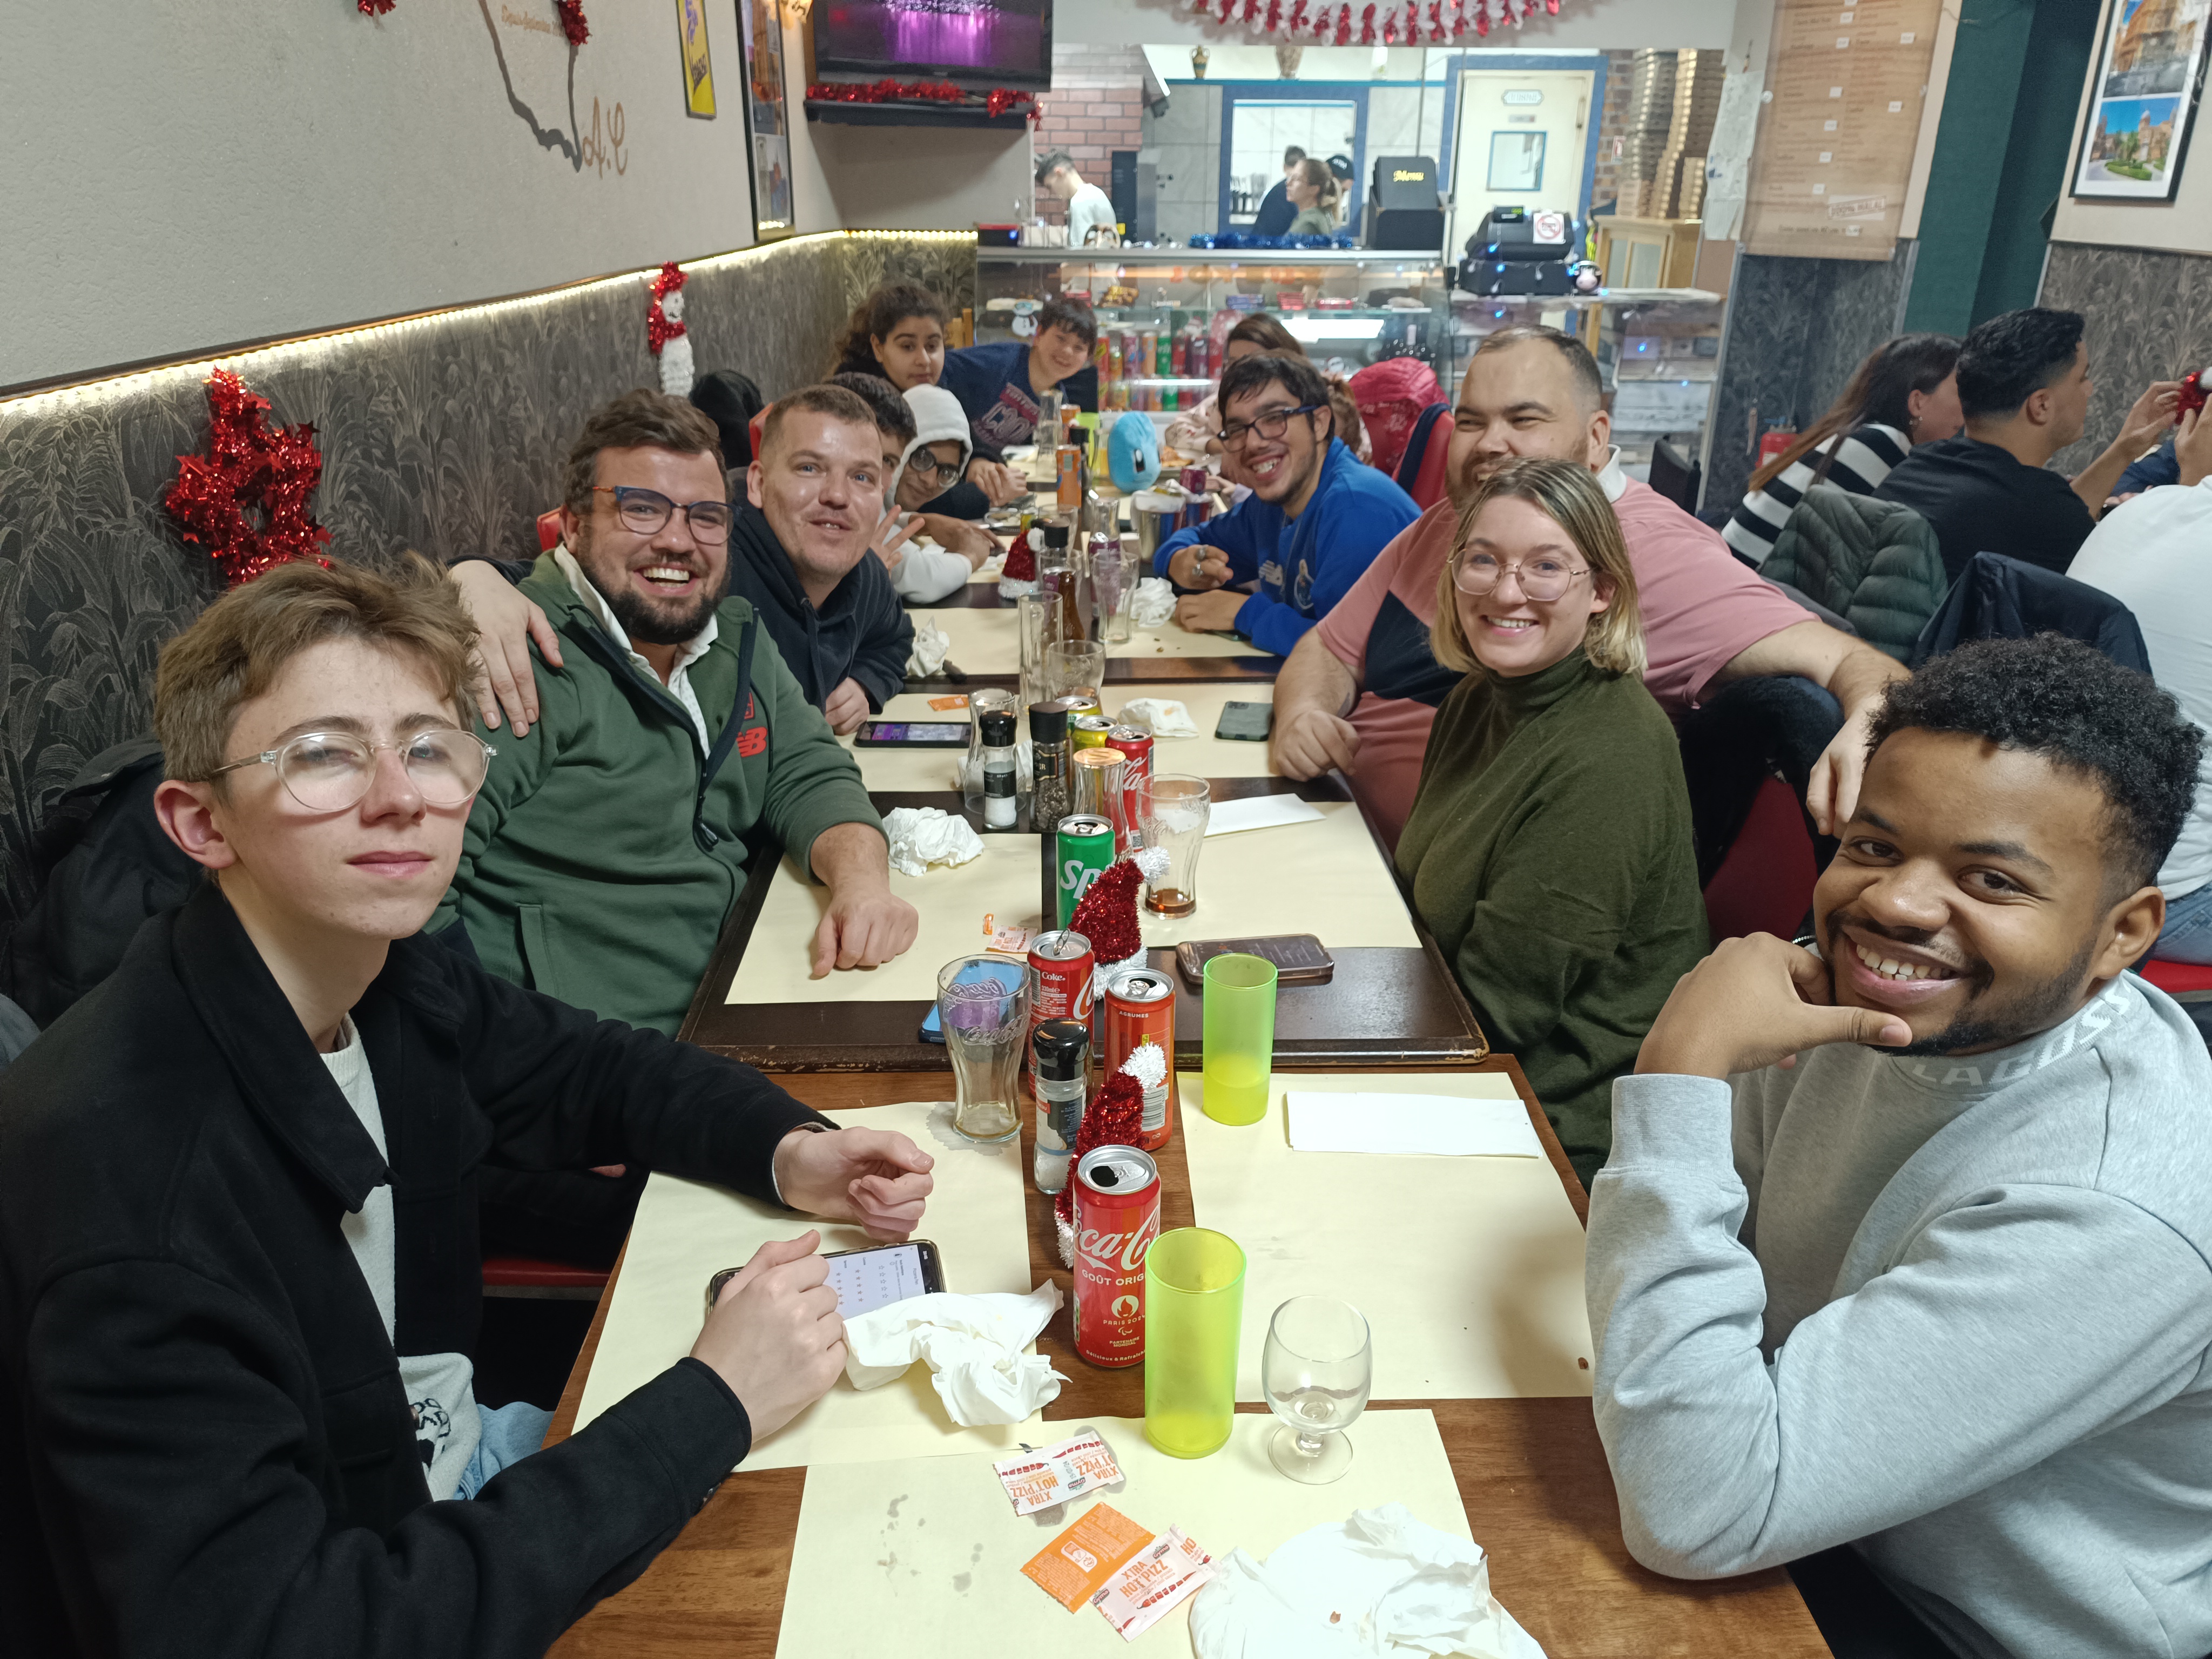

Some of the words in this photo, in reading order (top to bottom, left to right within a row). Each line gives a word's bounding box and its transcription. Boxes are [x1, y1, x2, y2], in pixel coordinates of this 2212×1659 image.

[1393, 170, 1424, 182] Menu
[1082, 1269, 1111, 1285] GOÛT
[1128, 1314, 1145, 1324] 2024
[1109, 1336, 1140, 1344] PARTENAIRE
[1093, 1466, 1119, 1480] XTRA
[1010, 1475, 1059, 1498] HOT'PIZZ
[1068, 1478, 1085, 1488] Gyma
[1027, 1491, 1053, 1506] XTRA
[1153, 1544, 1170, 1559] Gyma
[1120, 1559, 1169, 1597] HOT'PIZZ
[1121, 1561, 1148, 1580] XTRA
